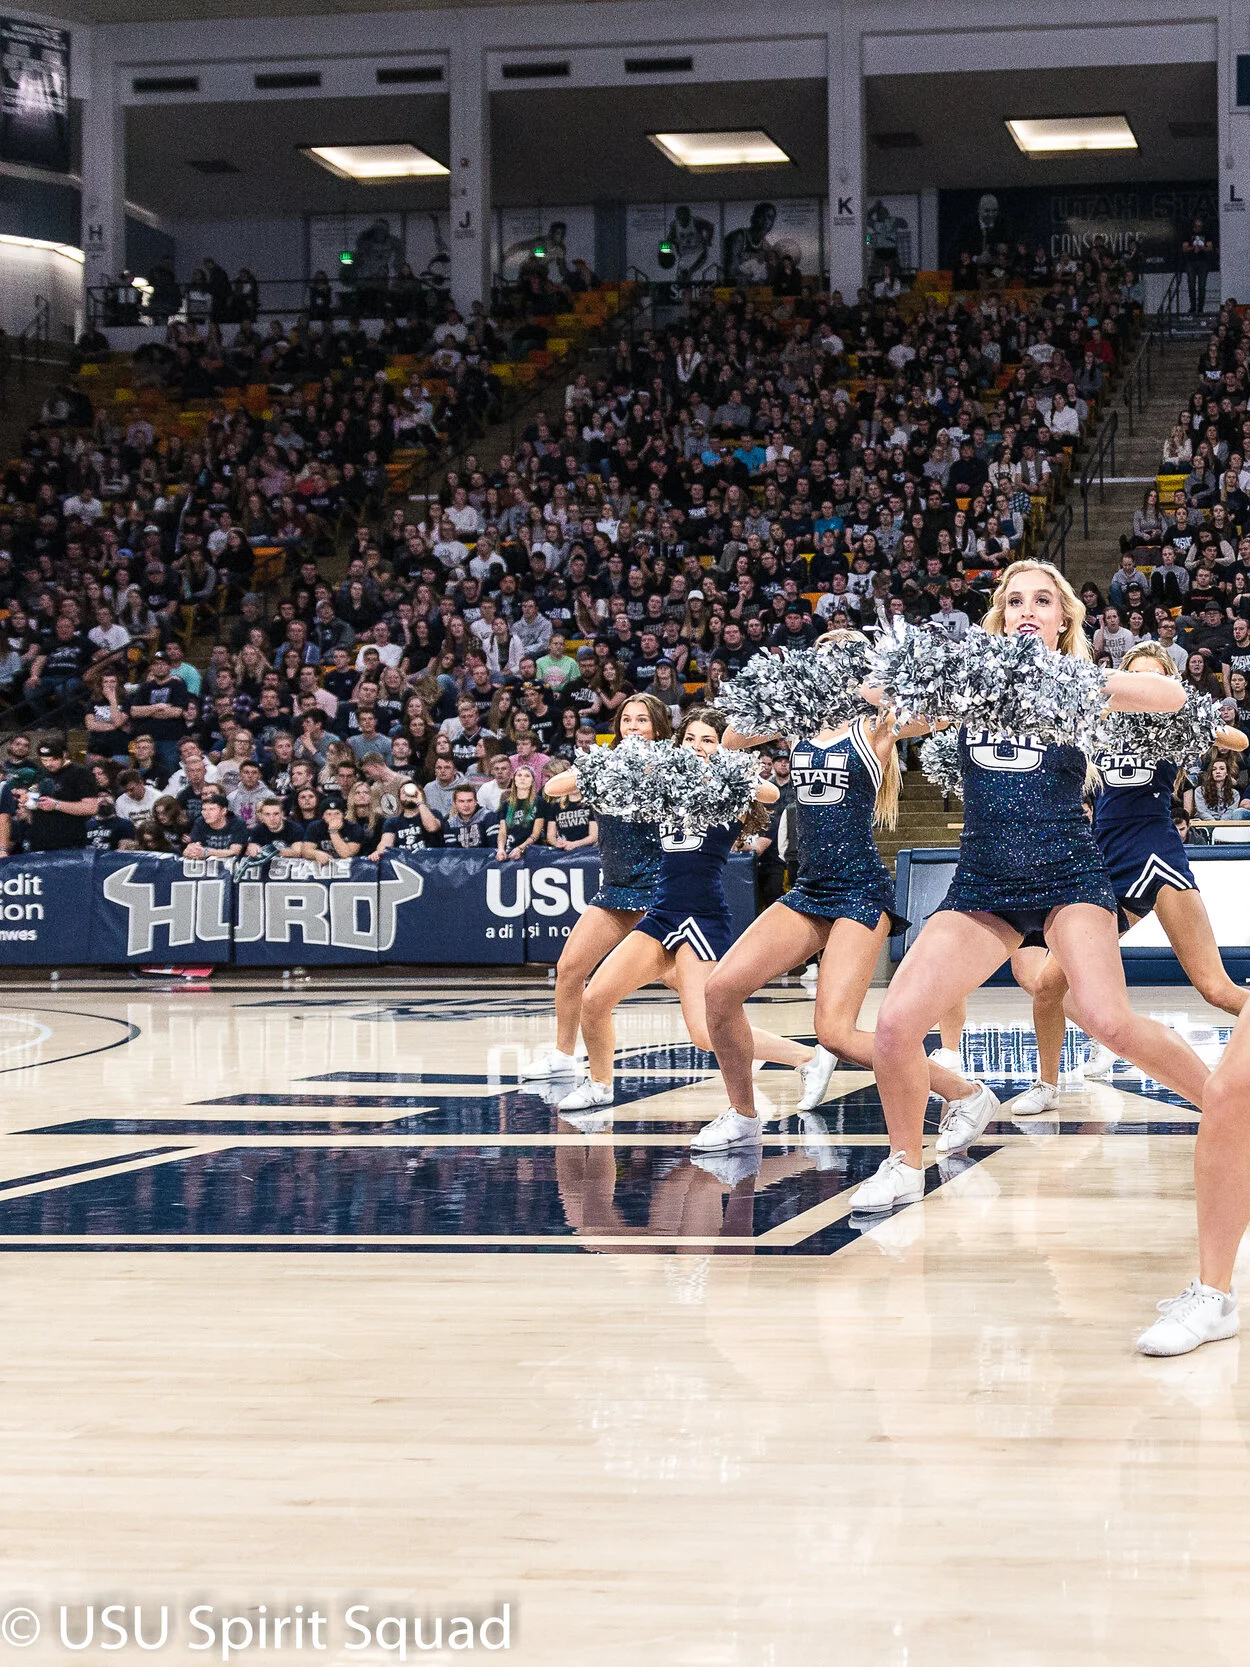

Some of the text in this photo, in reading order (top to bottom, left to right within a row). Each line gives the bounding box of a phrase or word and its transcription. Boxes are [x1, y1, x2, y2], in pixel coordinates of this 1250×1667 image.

[1230, 185, 1243, 202] L
[837, 198, 853, 215] K
[459, 211, 470, 229] J
[89, 224, 102, 240] H
[792, 768, 850, 788] STATE
[486, 867, 603, 918] USU
